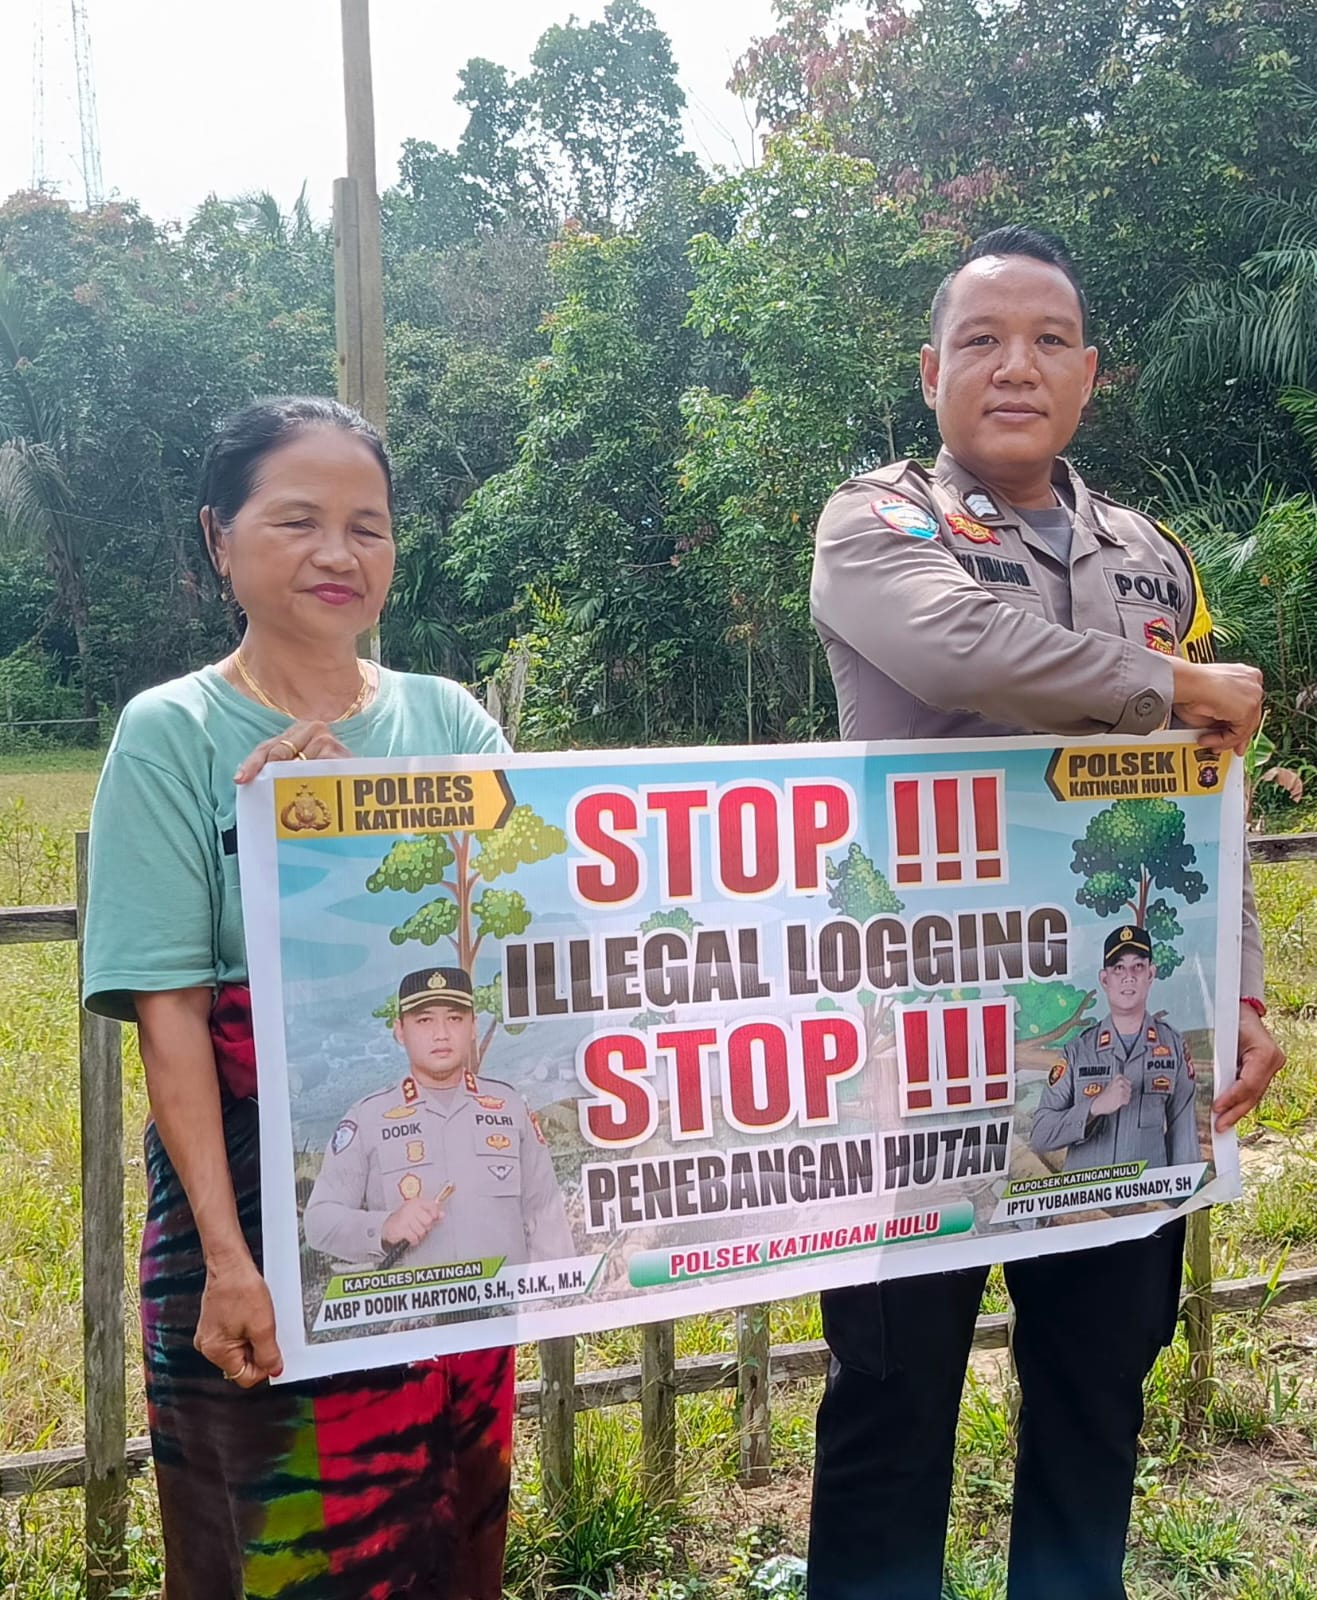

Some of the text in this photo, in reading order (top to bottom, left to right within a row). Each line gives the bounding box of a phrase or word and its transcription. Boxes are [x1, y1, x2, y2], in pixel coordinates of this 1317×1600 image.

[1068, 752, 1175, 777] POLSEK
[353, 775, 473, 806] POLRES
[1069, 778, 1177, 797] KATINGAN HULU
[355, 805, 475, 831] KATINGAN
[574, 777, 1001, 904] STOP !!!
[506, 908, 1068, 1018] ILLEGAL LOGGING
[584, 1004, 1008, 1141] STOP !!!
[1147, 1059, 1175, 1071] POLRI
[382, 1122, 422, 1141] DODIK
[476, 1114, 513, 1126] POLRI
[587, 1122, 1009, 1228] PENEBANGAN HUTAN
[1011, 1165, 1138, 1193] KAPOLSEK KATINGAN HULU
[1007, 1176, 1192, 1216] IPTU YUBAMBANG KUSNADY, SH
[670, 1212, 940, 1276] POLSEK KATINGAN HULU
[343, 1263, 482, 1292] KAPOLRES KATINGAN
[324, 1303, 360, 1322] AKBP
[365, 1295, 408, 1315] DODIK
[412, 1284, 480, 1309] HARTONO,
[558, 1271, 586, 1290] M.H.
